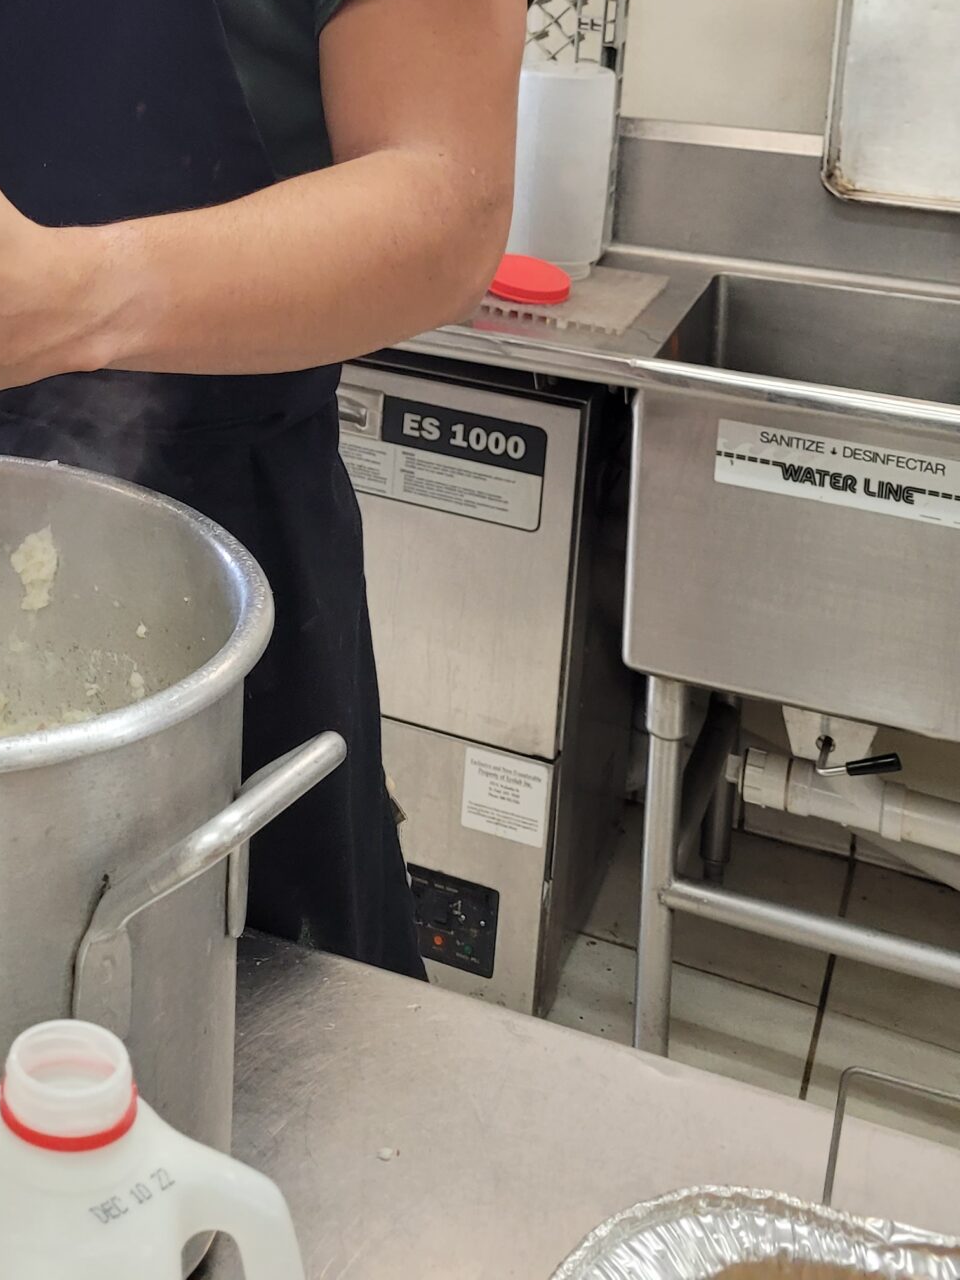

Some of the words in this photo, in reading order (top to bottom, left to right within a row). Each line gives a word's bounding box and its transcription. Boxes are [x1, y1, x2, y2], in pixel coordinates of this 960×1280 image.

[401, 411, 441, 441] ES
[449, 422, 526, 460] 1000
[759, 430, 825, 454] SANITIZE
[842, 445, 946, 476] DESINFECTAR
[779, 462, 858, 494] WATER
[863, 477, 920, 505] LINE
[88, 1195, 129, 1224] DEC
[129, 1182, 153, 1205] 10
